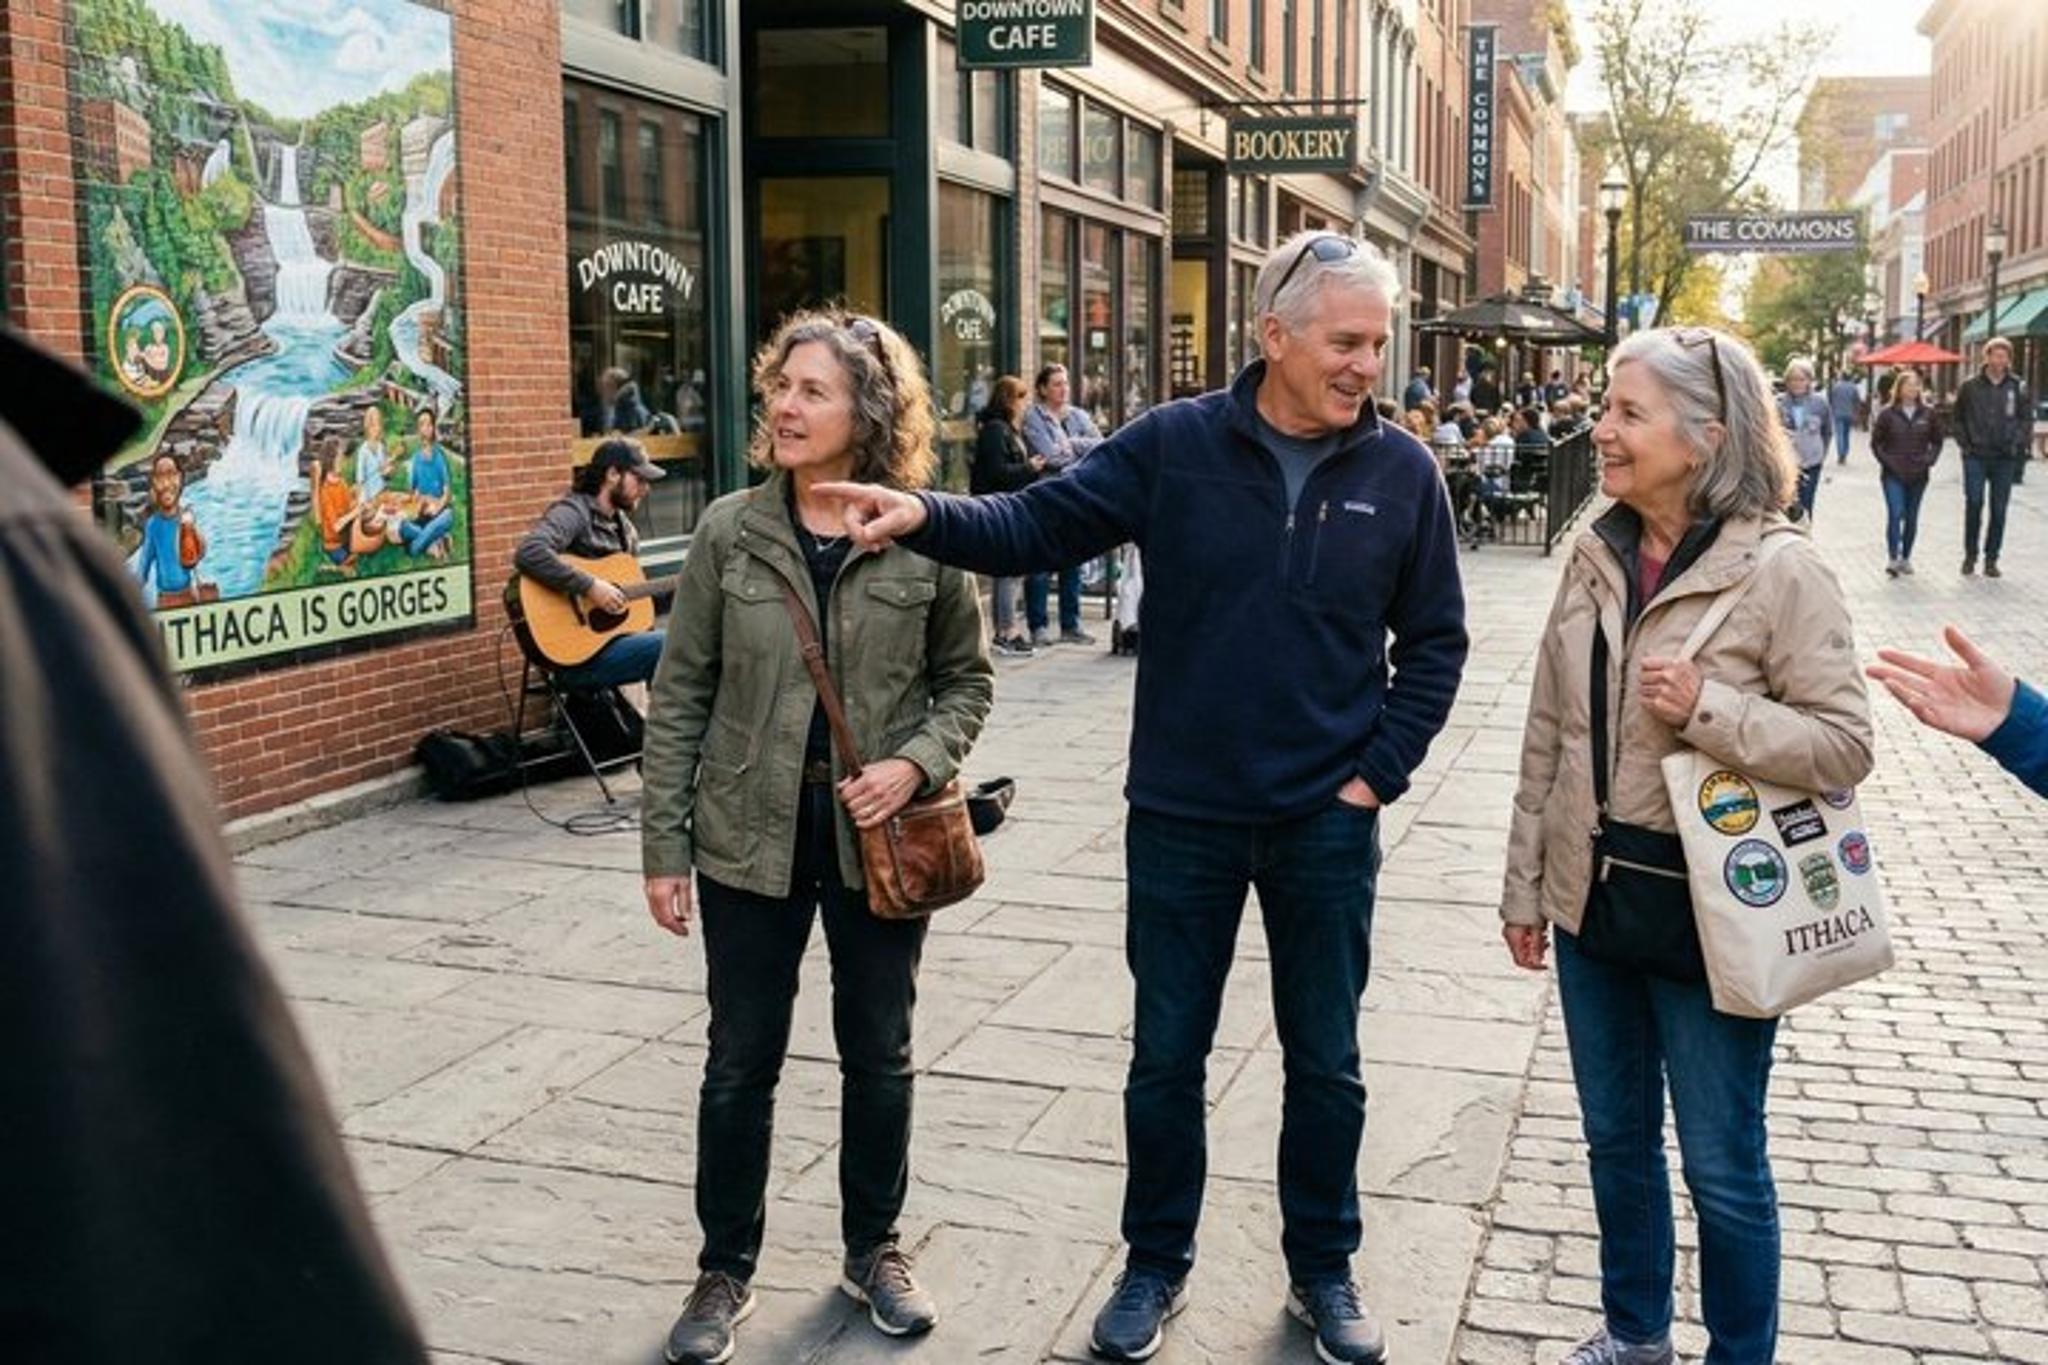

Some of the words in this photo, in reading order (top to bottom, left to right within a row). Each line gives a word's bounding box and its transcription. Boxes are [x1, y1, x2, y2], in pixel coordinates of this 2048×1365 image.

[962, 0, 1083, 21] DOWNTOWN
[988, 24, 1057, 50] CAFE
[1475, 38, 1489, 80] THE
[1234, 130, 1350, 160] BOOKERY
[1472, 93, 1489, 196] COMMONS
[1689, 219, 1731, 240] THE
[1737, 218, 1855, 240] COMMONS
[577, 241, 695, 300] DOWNTOWN
[613, 281, 663, 314] CAFE
[300, 594, 328, 637] IS
[337, 576, 448, 628] GORGES
[1784, 903, 1875, 956] ITHACA
